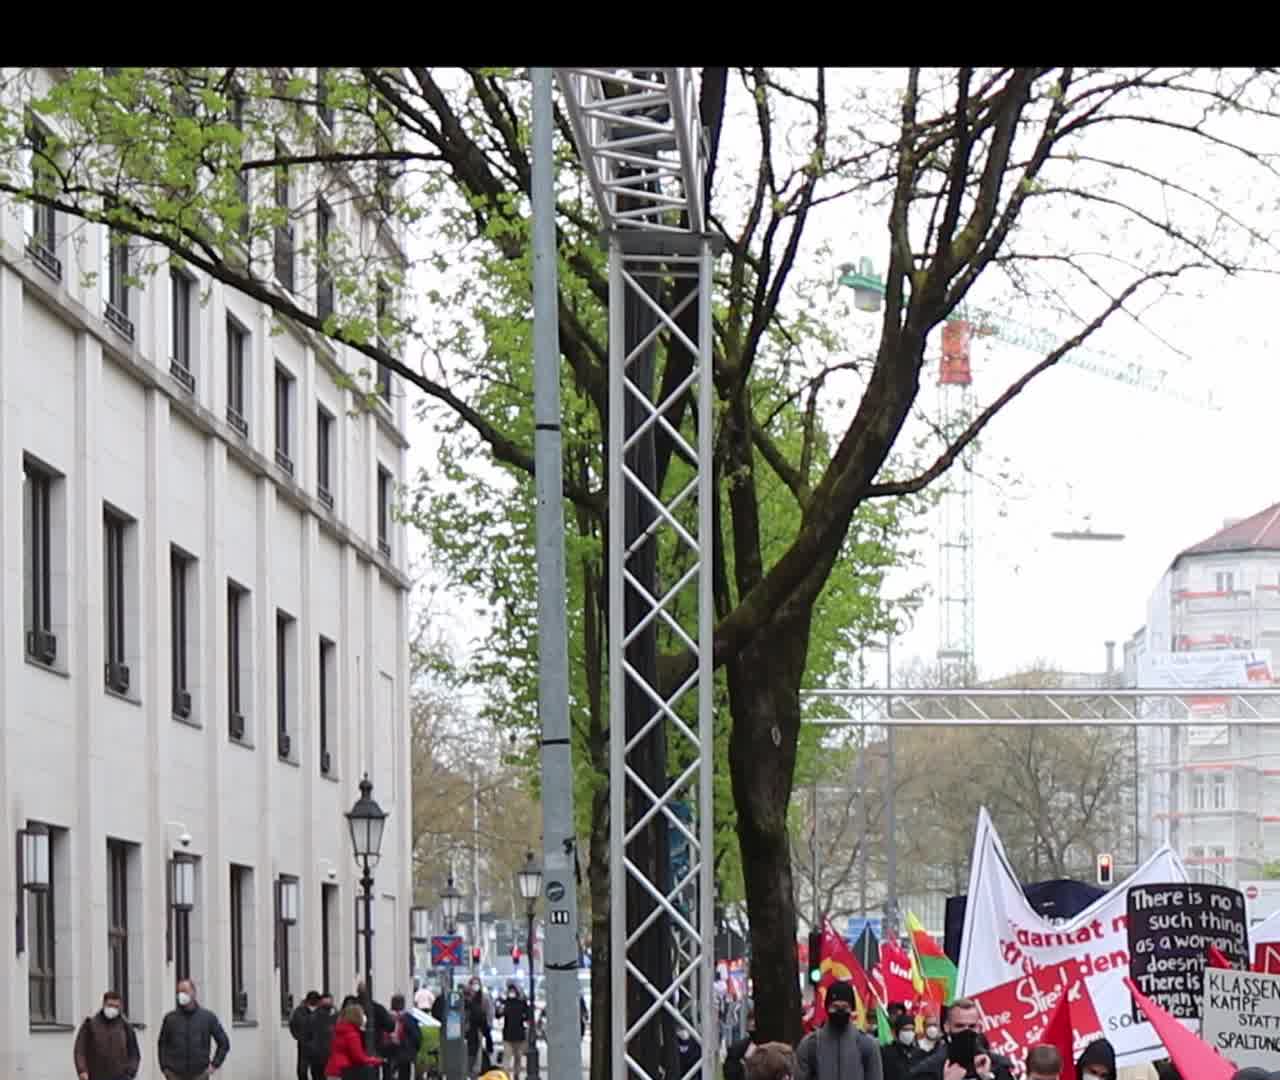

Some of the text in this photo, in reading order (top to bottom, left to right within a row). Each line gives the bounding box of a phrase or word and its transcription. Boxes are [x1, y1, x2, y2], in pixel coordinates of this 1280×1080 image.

[1132, 889, 1183, 911] There
[1188, 886, 1203, 905] is
[1211, 893, 1232, 910] no
[1149, 912, 1193, 931] such
[1200, 912, 1244, 945] thing
[1135, 938, 1154, 953] as
[1160, 936, 1171, 949] a
[1176, 934, 1233, 953] woman
[1137, 972, 1200, 992] There is
[1148, 992, 1192, 1009] oman
[1210, 993, 1261, 1013] KAMPF
